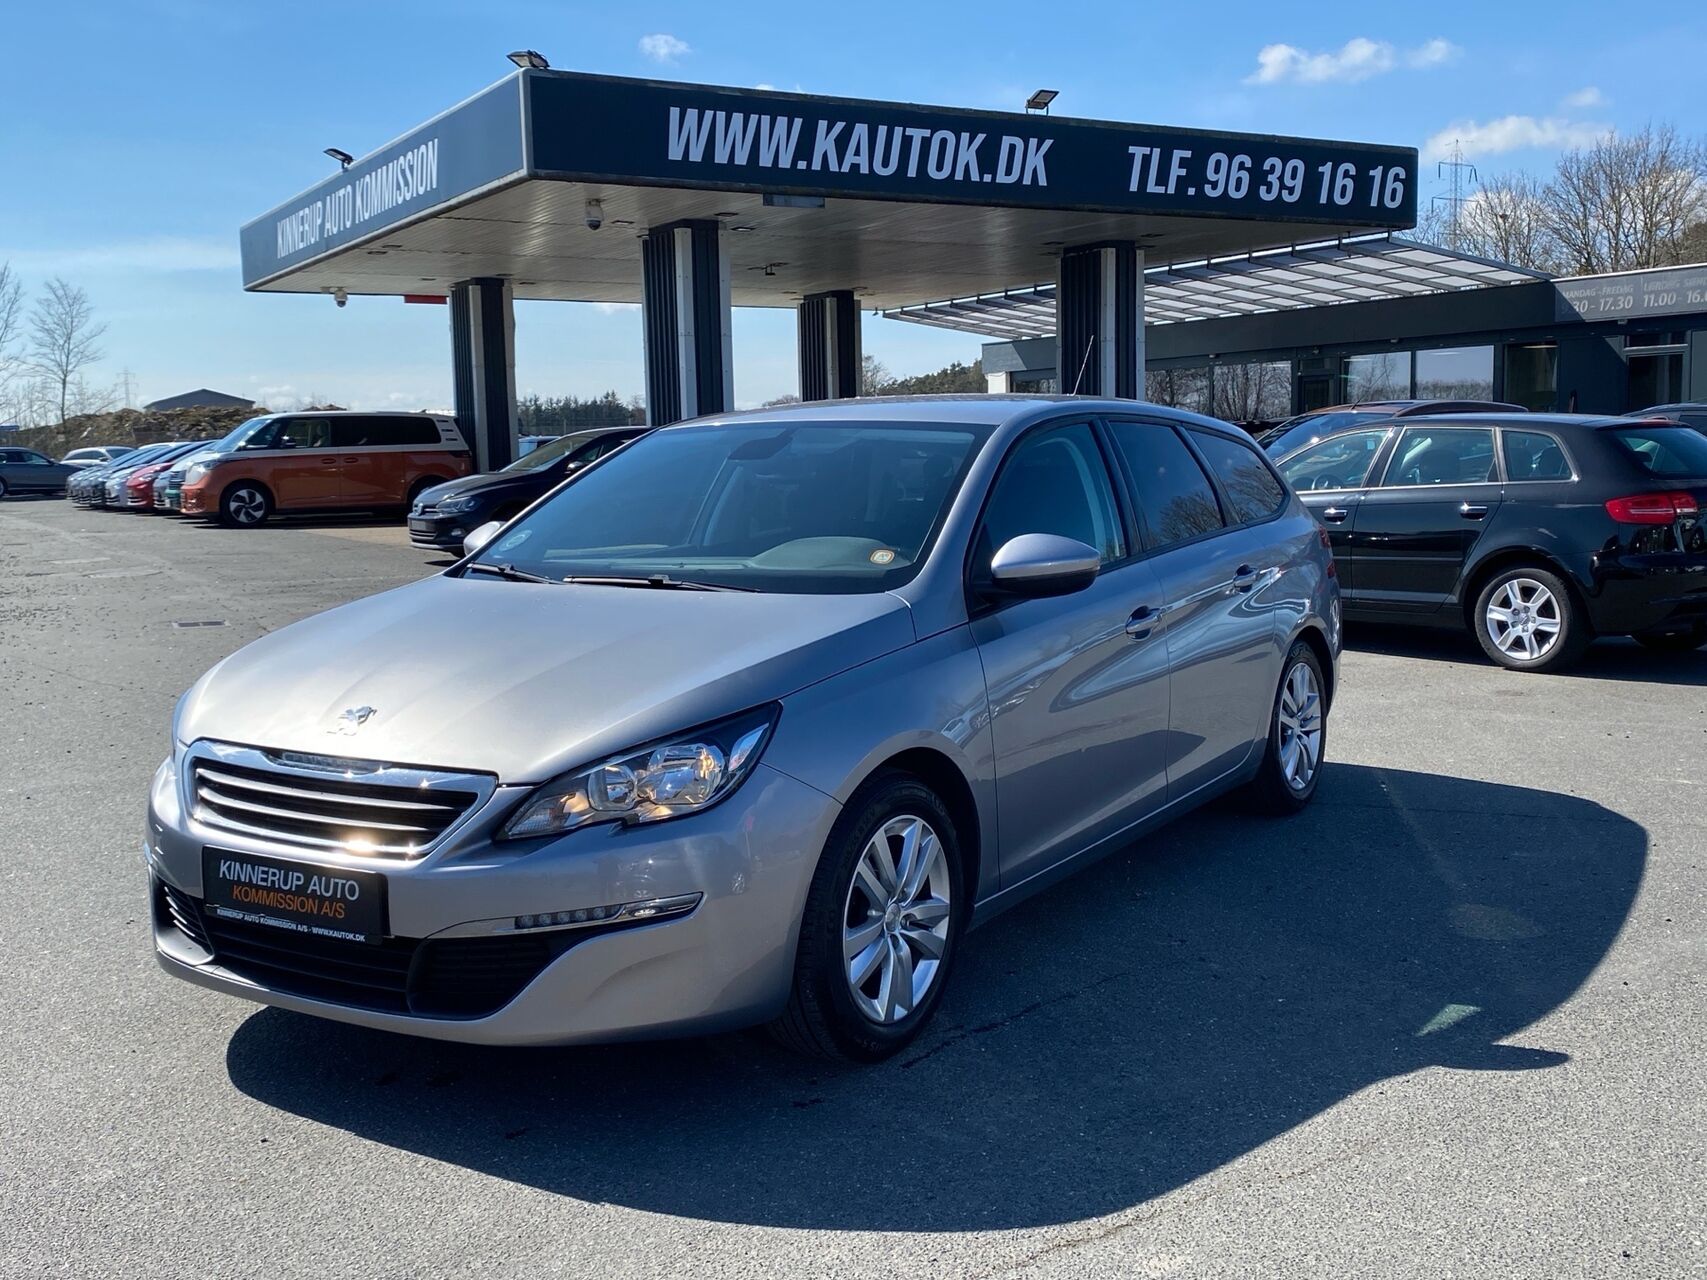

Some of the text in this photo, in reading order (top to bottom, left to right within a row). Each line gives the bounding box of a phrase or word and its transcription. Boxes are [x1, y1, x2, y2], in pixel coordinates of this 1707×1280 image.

[668, 106, 1055, 187] WWW.KAUTOK.DK
[1128, 145, 1406, 209] TLF. 96 39 16 16
[277, 138, 439, 259] KINNERUP AUTO KOMMISSION
[1600, 295, 1633, 311] 17.30
[1643, 292, 1677, 308] 11.00
[219, 859, 359, 900] KINNERUP AUTO
[232, 885, 345, 919] KOMMISSION A/S
[244, 913, 260, 923] AUTO
[260, 916, 297, 930] KOMMISSION
[297, 923, 309, 932] A/S
